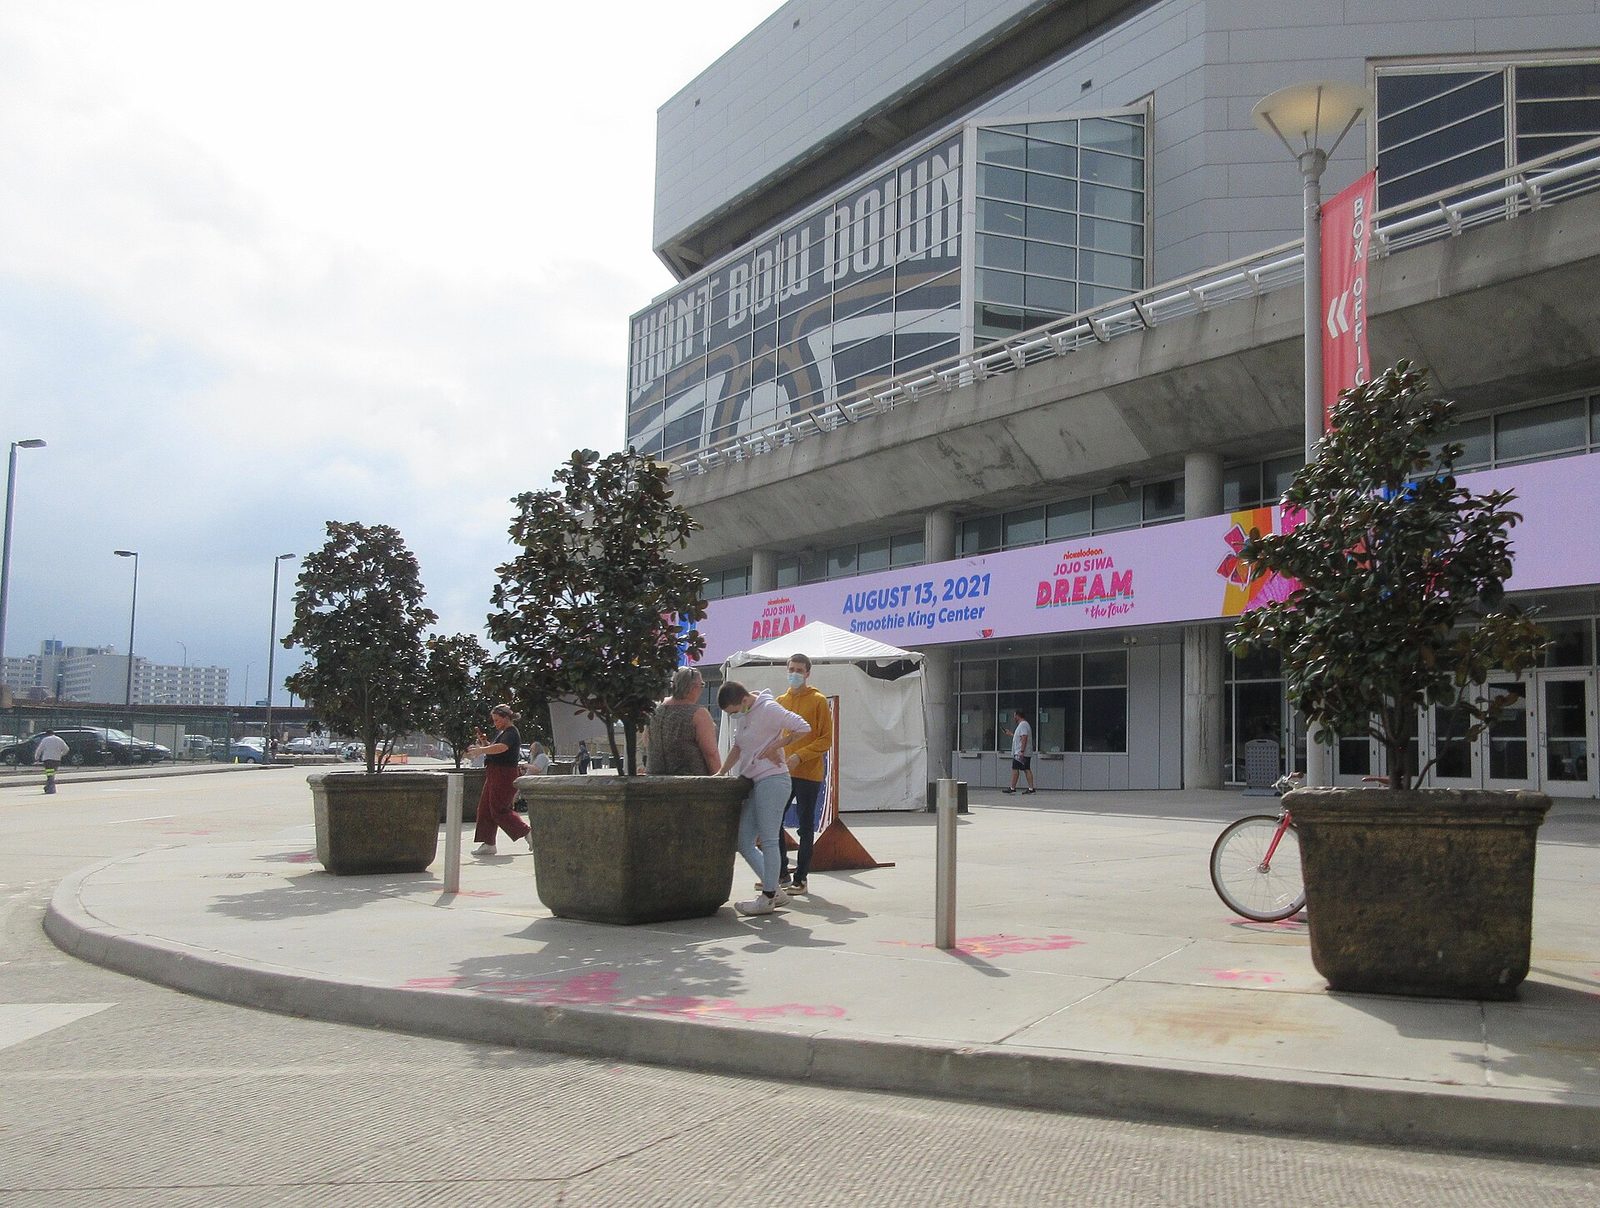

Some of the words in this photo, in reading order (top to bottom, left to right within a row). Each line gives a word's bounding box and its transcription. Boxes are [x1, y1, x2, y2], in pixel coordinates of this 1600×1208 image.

[1352, 197, 1364, 263] BOX
[631, 277, 720, 404] WON'T
[728, 227, 810, 329] BOW
[823, 143, 960, 284] DOWN
[1352, 276, 1365, 387] OFFIC
[1053, 561, 1081, 577] JOJO
[1083, 556, 1114, 572] SIWA
[762, 608, 778, 617] JOJO
[779, 604, 796, 615] SIWA
[843, 585, 911, 615] AUGUST
[914, 581, 938, 607] 13,
[942, 573, 991, 601] 2021
[850, 613, 905, 633] Smoothie
[907, 610, 936, 629] King
[938, 606, 985, 624] Center
[1090, 604, 1106, 619] the
